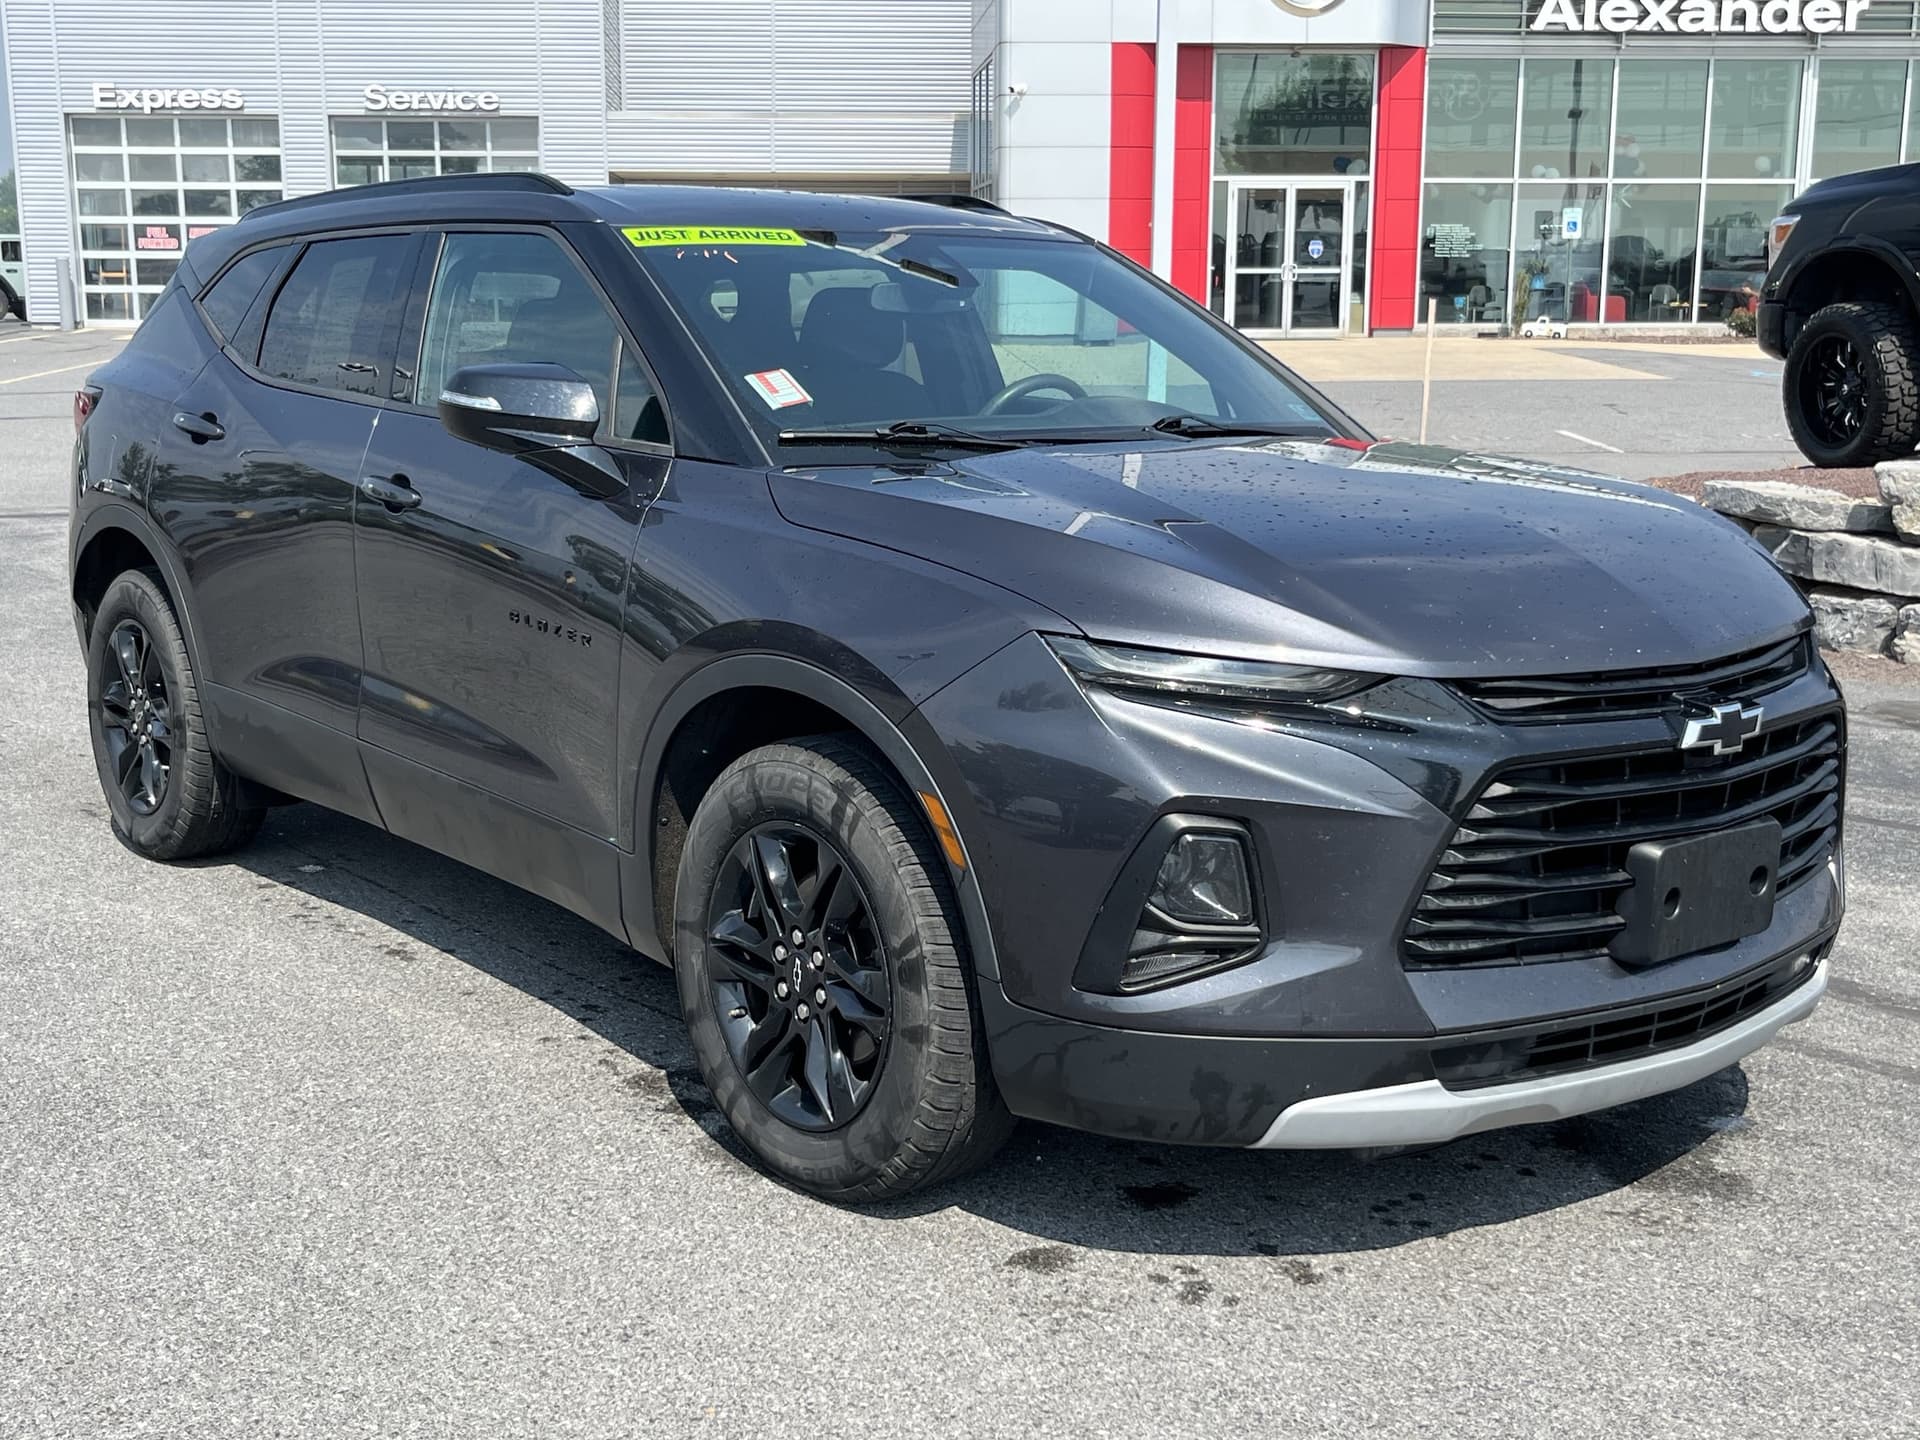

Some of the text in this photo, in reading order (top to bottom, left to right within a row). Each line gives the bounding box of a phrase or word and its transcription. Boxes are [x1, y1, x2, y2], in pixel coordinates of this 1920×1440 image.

[1531, 0, 1869, 33] Alexander
[92, 82, 244, 115] Express
[364, 84, 500, 111] Service
[634, 230, 793, 242] JUST ARRIVED
[509, 609, 592, 648] BLAZER
